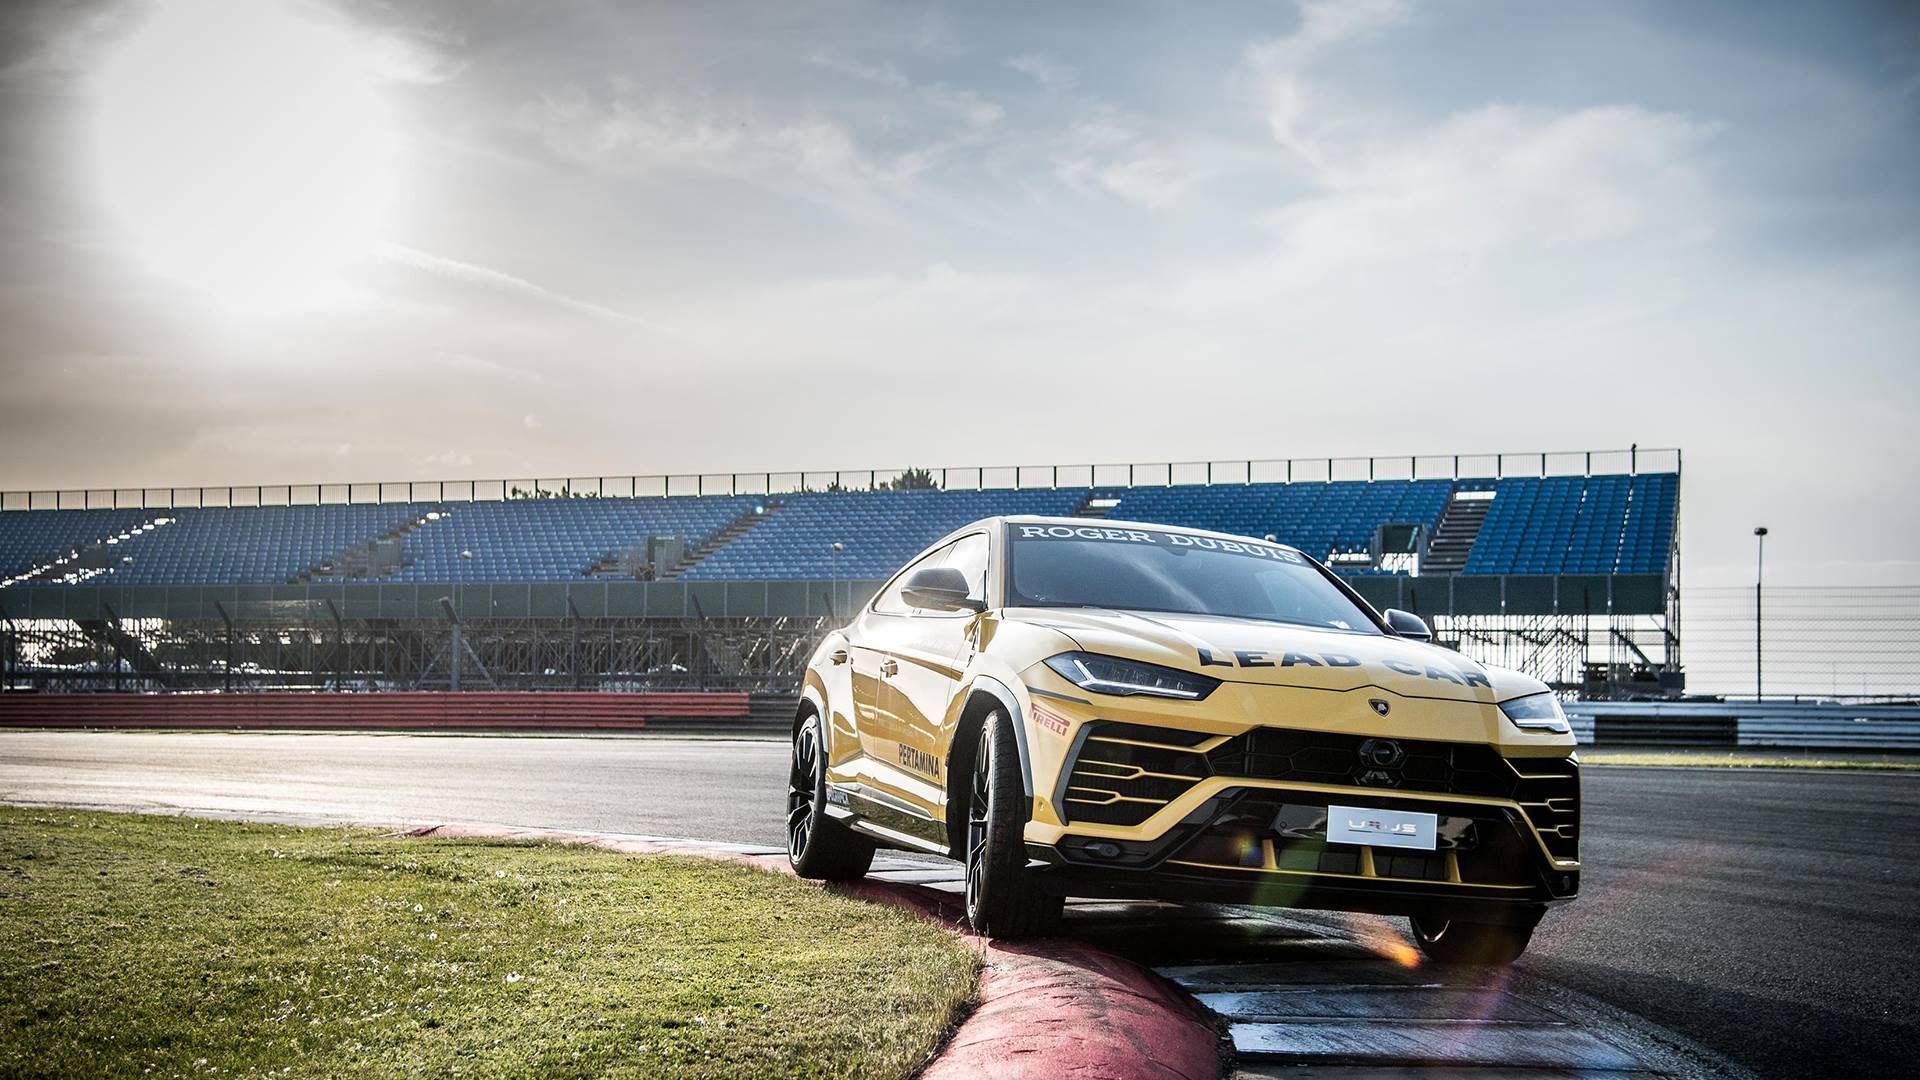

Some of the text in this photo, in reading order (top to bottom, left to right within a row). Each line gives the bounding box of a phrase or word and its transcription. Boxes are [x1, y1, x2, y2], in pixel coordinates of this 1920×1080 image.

[1019, 525, 1302, 563] ROGER DUBUIS
[1196, 647, 1493, 688] LEAD CAR
[1031, 702, 1070, 737] PIRELLI
[898, 743, 940, 780] PERTAMINA
